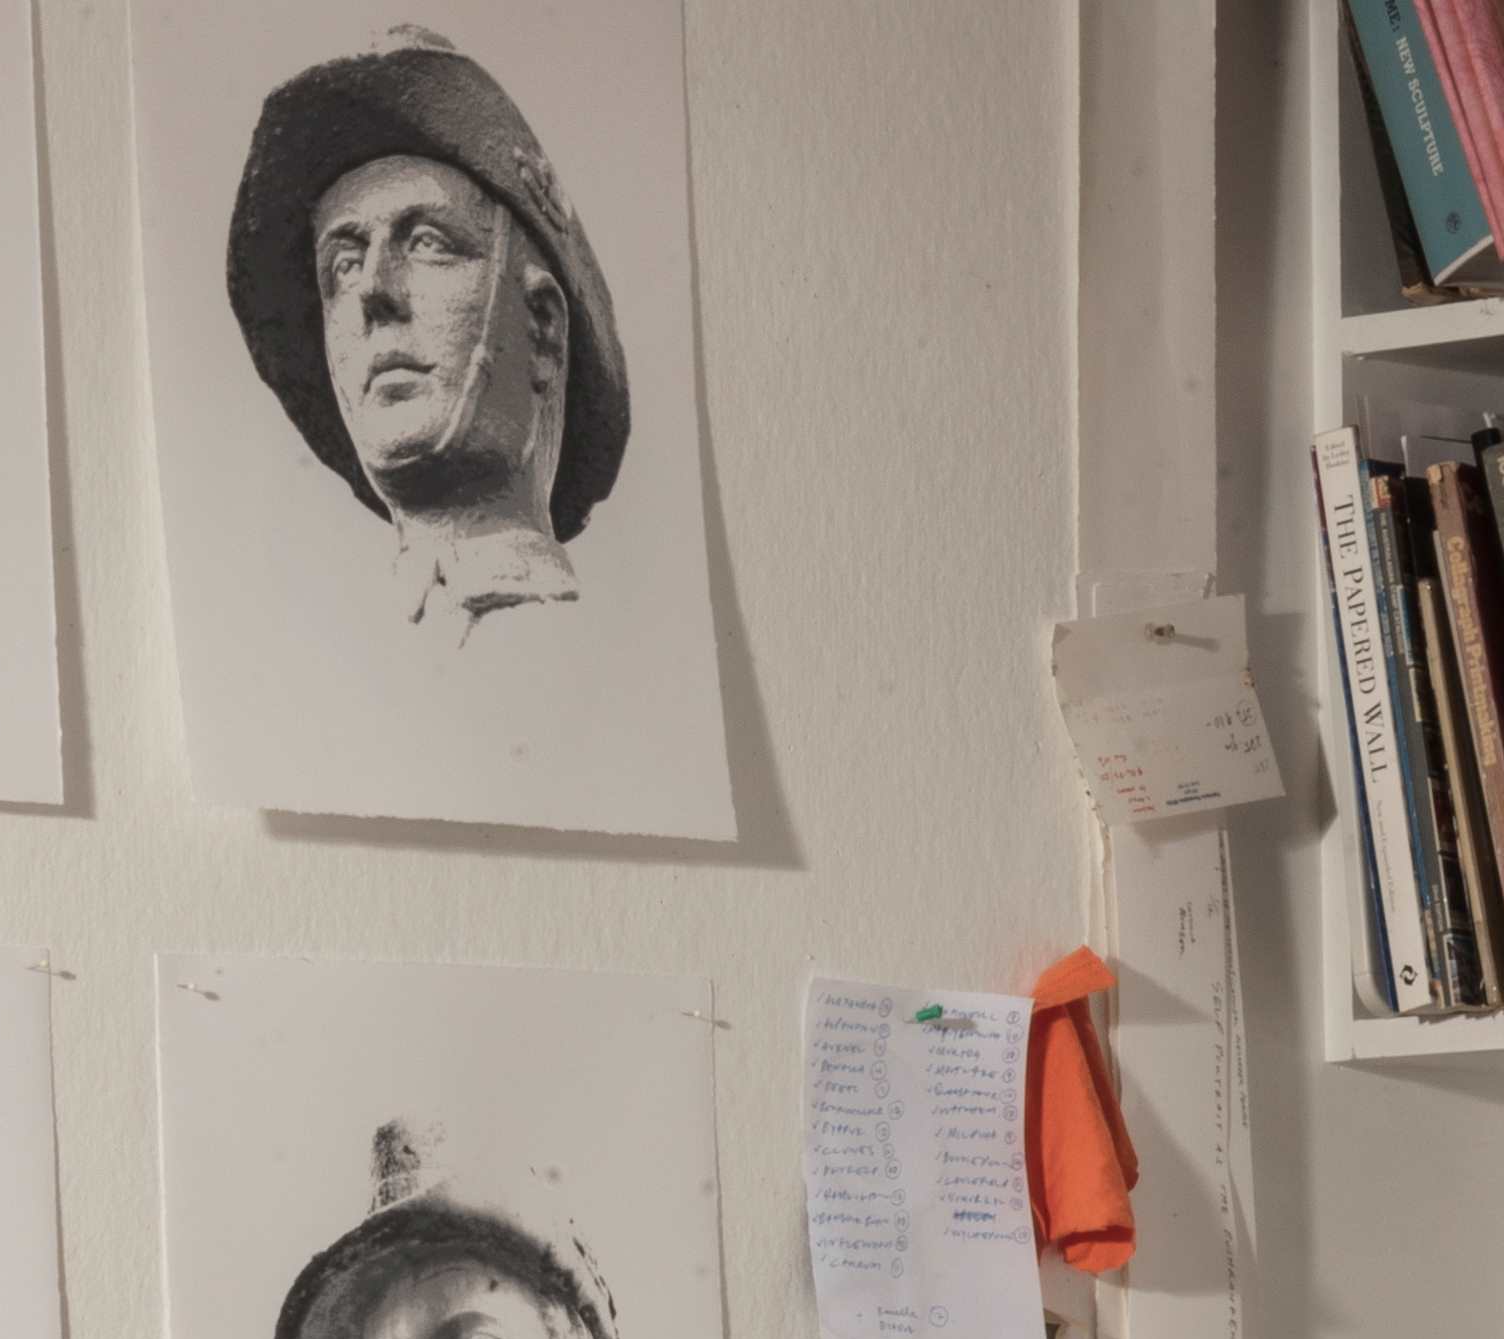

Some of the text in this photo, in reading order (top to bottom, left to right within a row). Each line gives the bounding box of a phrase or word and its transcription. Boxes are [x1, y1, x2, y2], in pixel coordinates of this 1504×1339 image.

[1396, 36, 1416, 75] NEW
[1408, 78, 1444, 177] SCULPTURE
[1334, 494, 1359, 559] THE
[1343, 565, 1378, 694] PAPERED
[1447, 536, 1497, 768] Collagraph Printmaking
[1363, 701, 1388, 784] WALL
